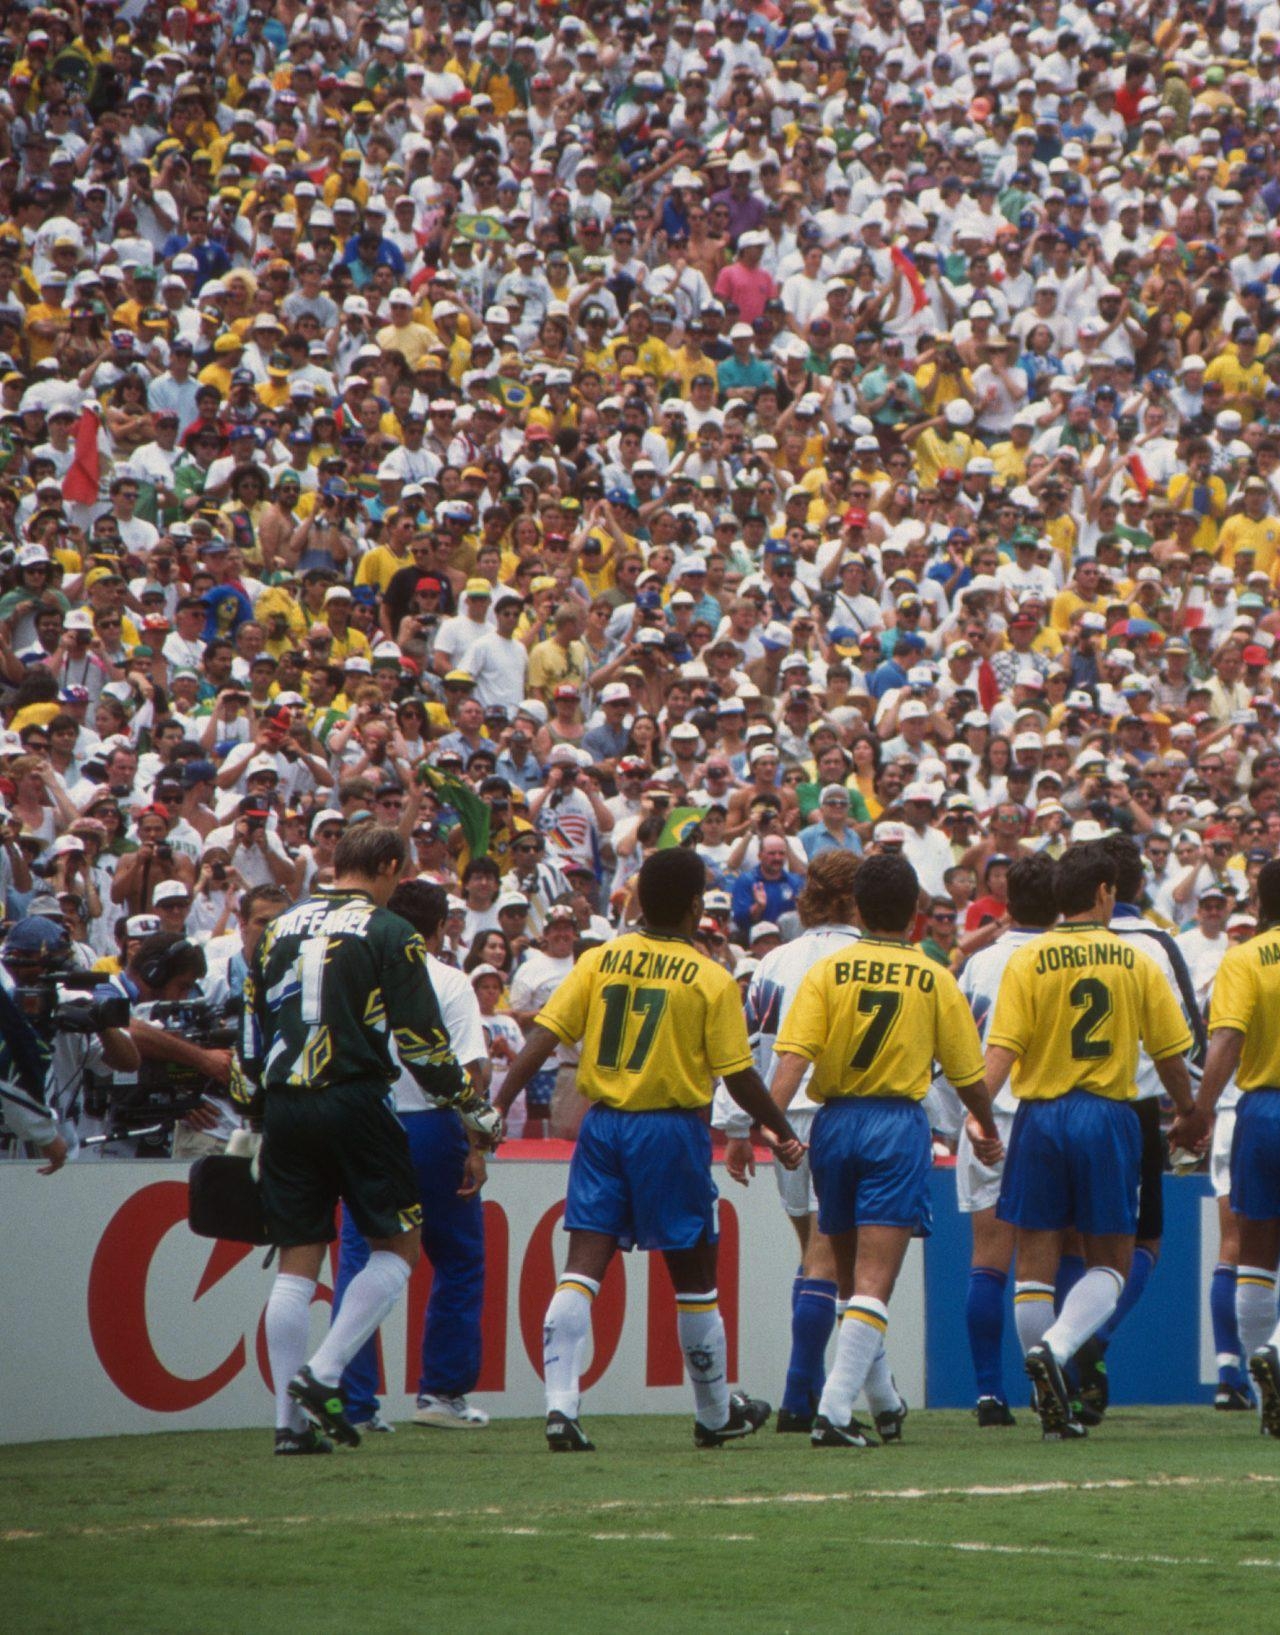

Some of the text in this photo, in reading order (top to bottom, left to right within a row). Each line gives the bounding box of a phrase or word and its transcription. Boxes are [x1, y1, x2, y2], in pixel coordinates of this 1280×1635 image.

[298, 936, 329, 1024] 1
[599, 949, 699, 985] MAZINHO
[835, 959, 935, 994] BEBETO
[1036, 943, 1135, 975] JORGINHO
[596, 983, 671, 1074] 17
[849, 989, 904, 1073] 7
[1069, 977, 1113, 1061] 2
